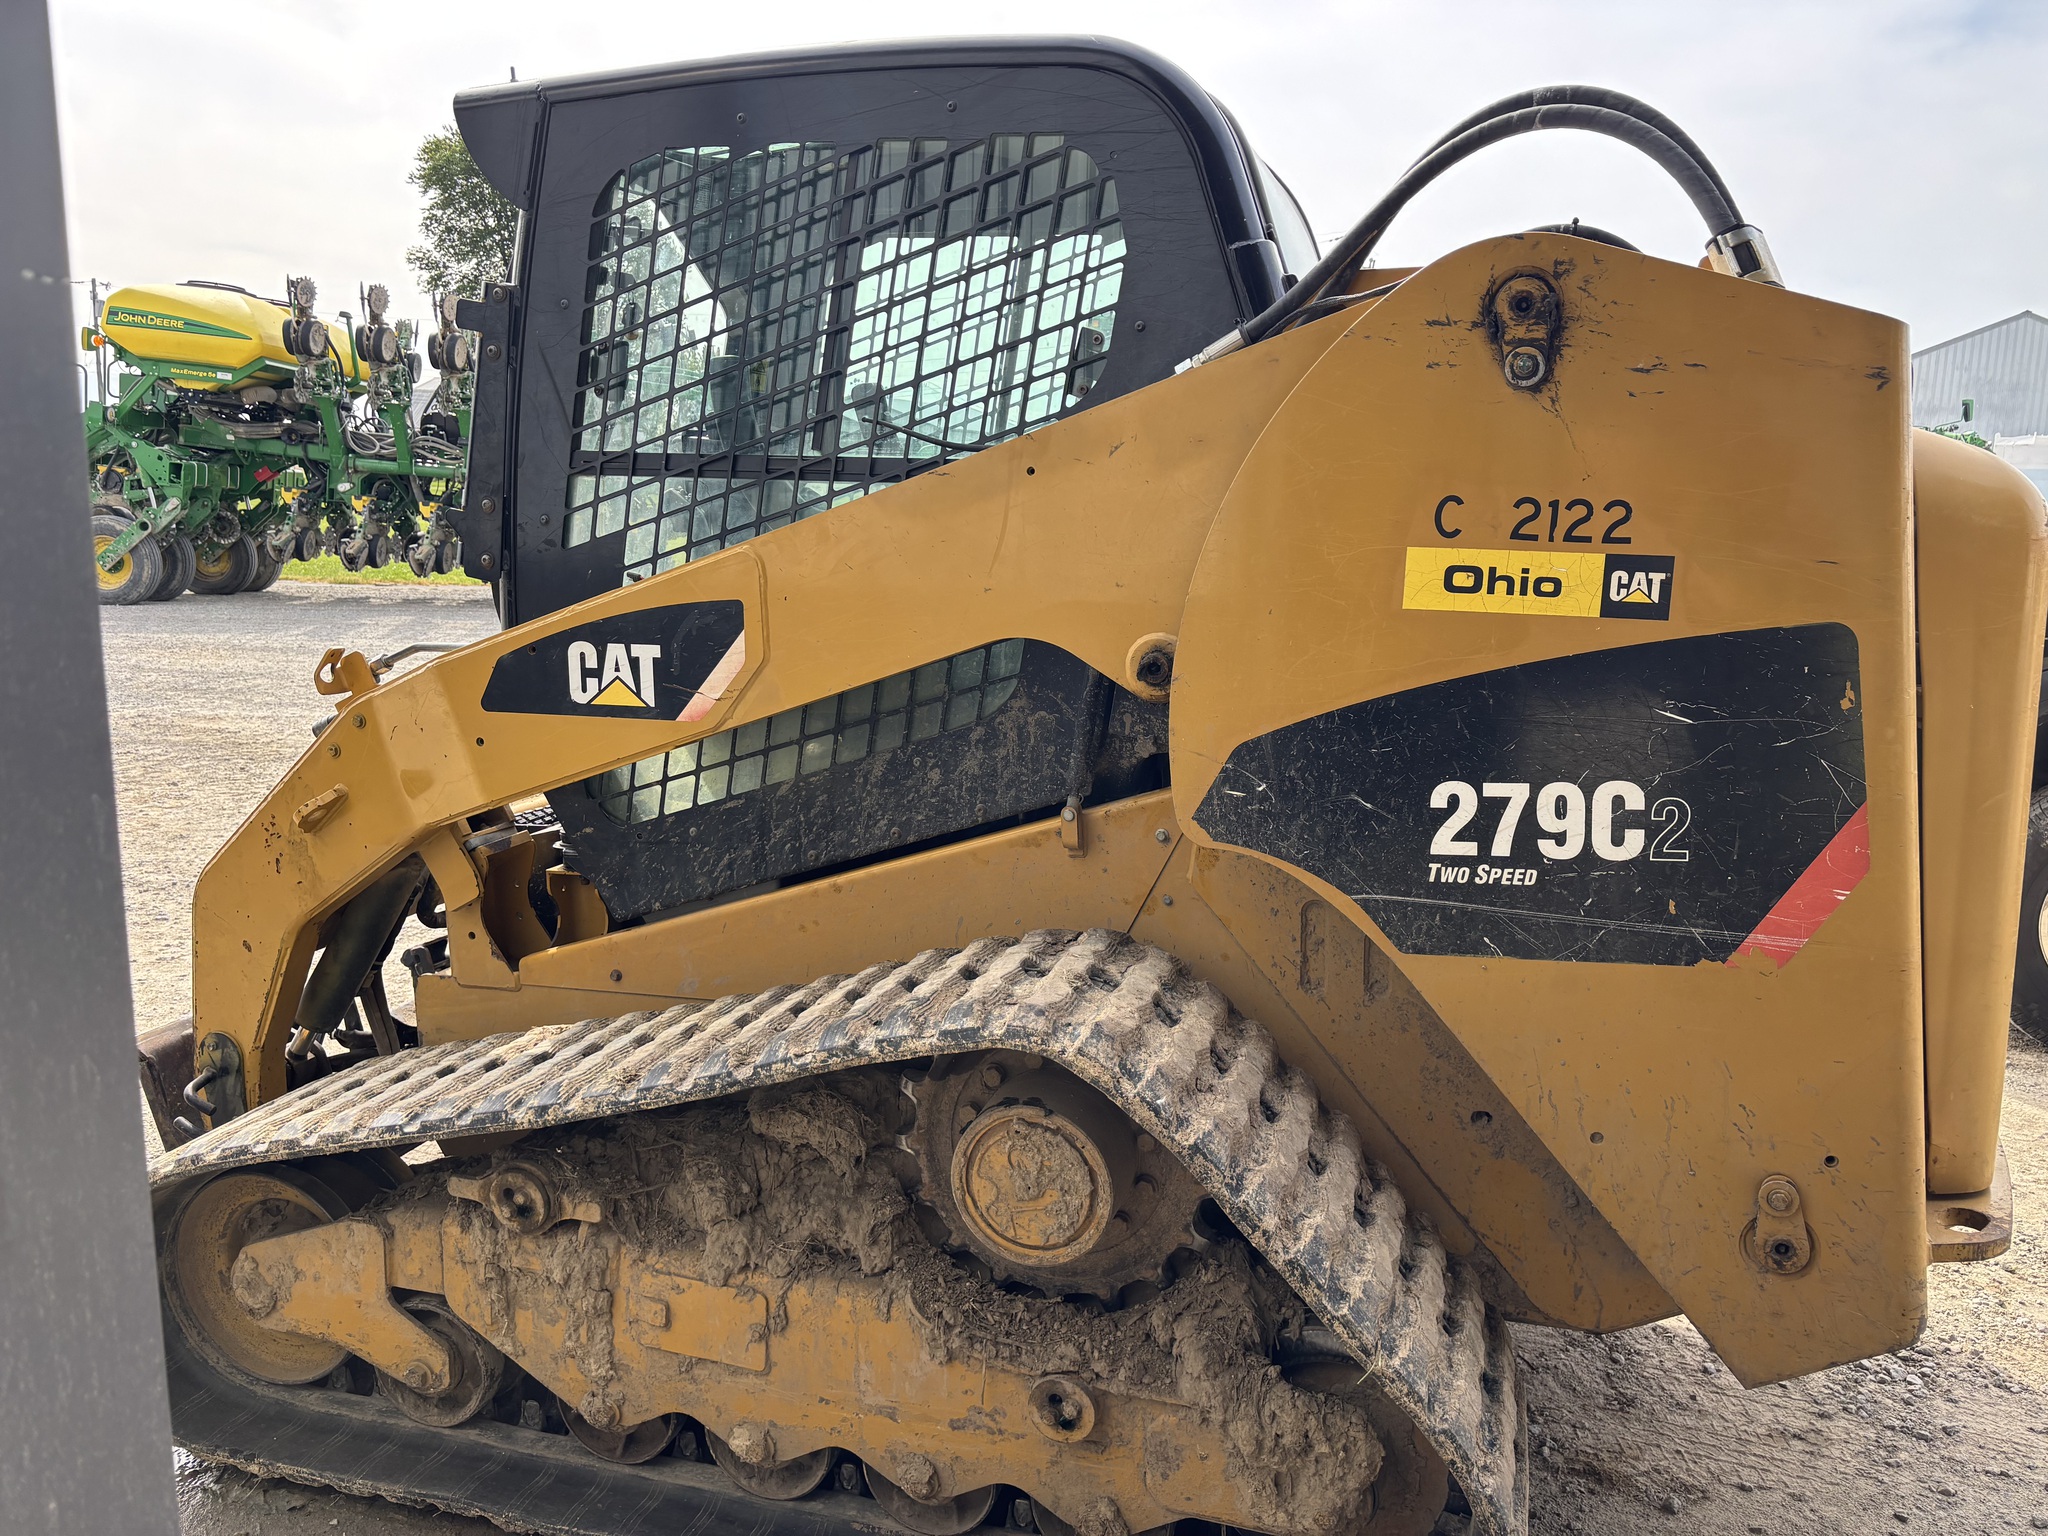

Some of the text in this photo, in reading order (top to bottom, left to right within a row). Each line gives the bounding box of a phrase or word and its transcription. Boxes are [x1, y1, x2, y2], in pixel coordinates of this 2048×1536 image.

[114, 311, 185, 329] JOHN DEERE
[170, 367, 207, 377] MaxEmerge
[1434, 494, 1633, 544] C 2122
[1443, 564, 1666, 604] Ohio CAT
[567, 640, 661, 708] CAT
